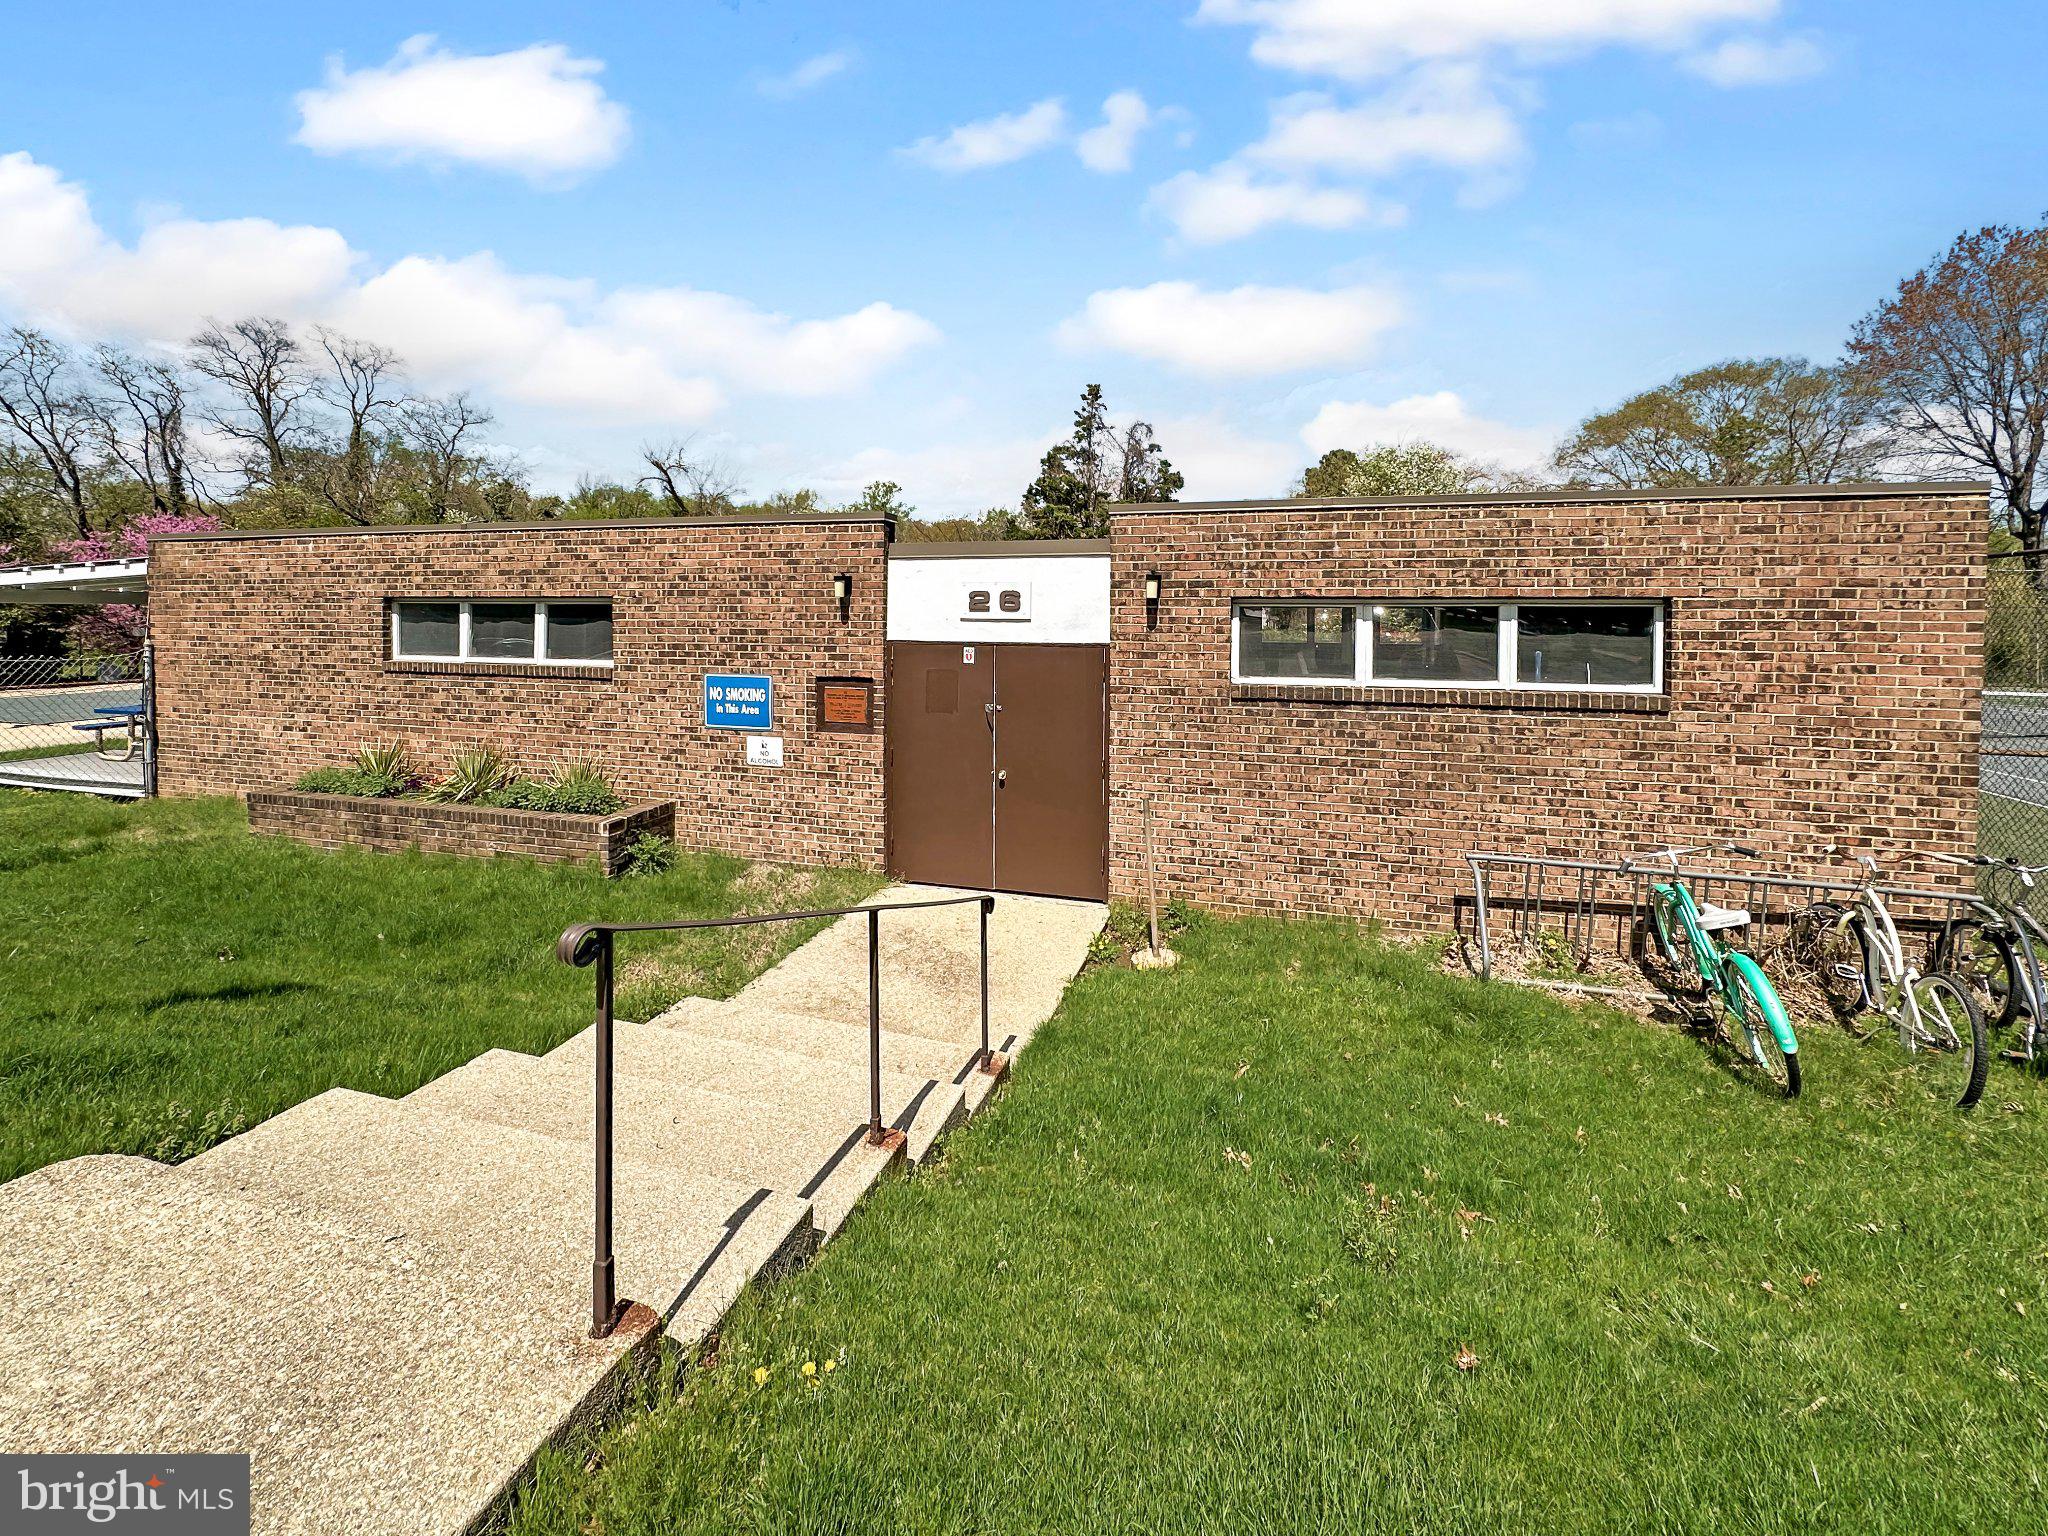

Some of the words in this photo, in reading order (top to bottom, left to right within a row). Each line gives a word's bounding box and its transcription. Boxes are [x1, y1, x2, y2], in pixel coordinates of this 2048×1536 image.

[969, 590, 1021, 612] 26
[709, 687, 723, 700] NO
[726, 688, 766, 702] SMOKING
[716, 703, 724, 713] in
[725, 704, 740, 714] This
[741, 704, 760, 714] Area
[750, 757, 779, 765] ALCOHOL
